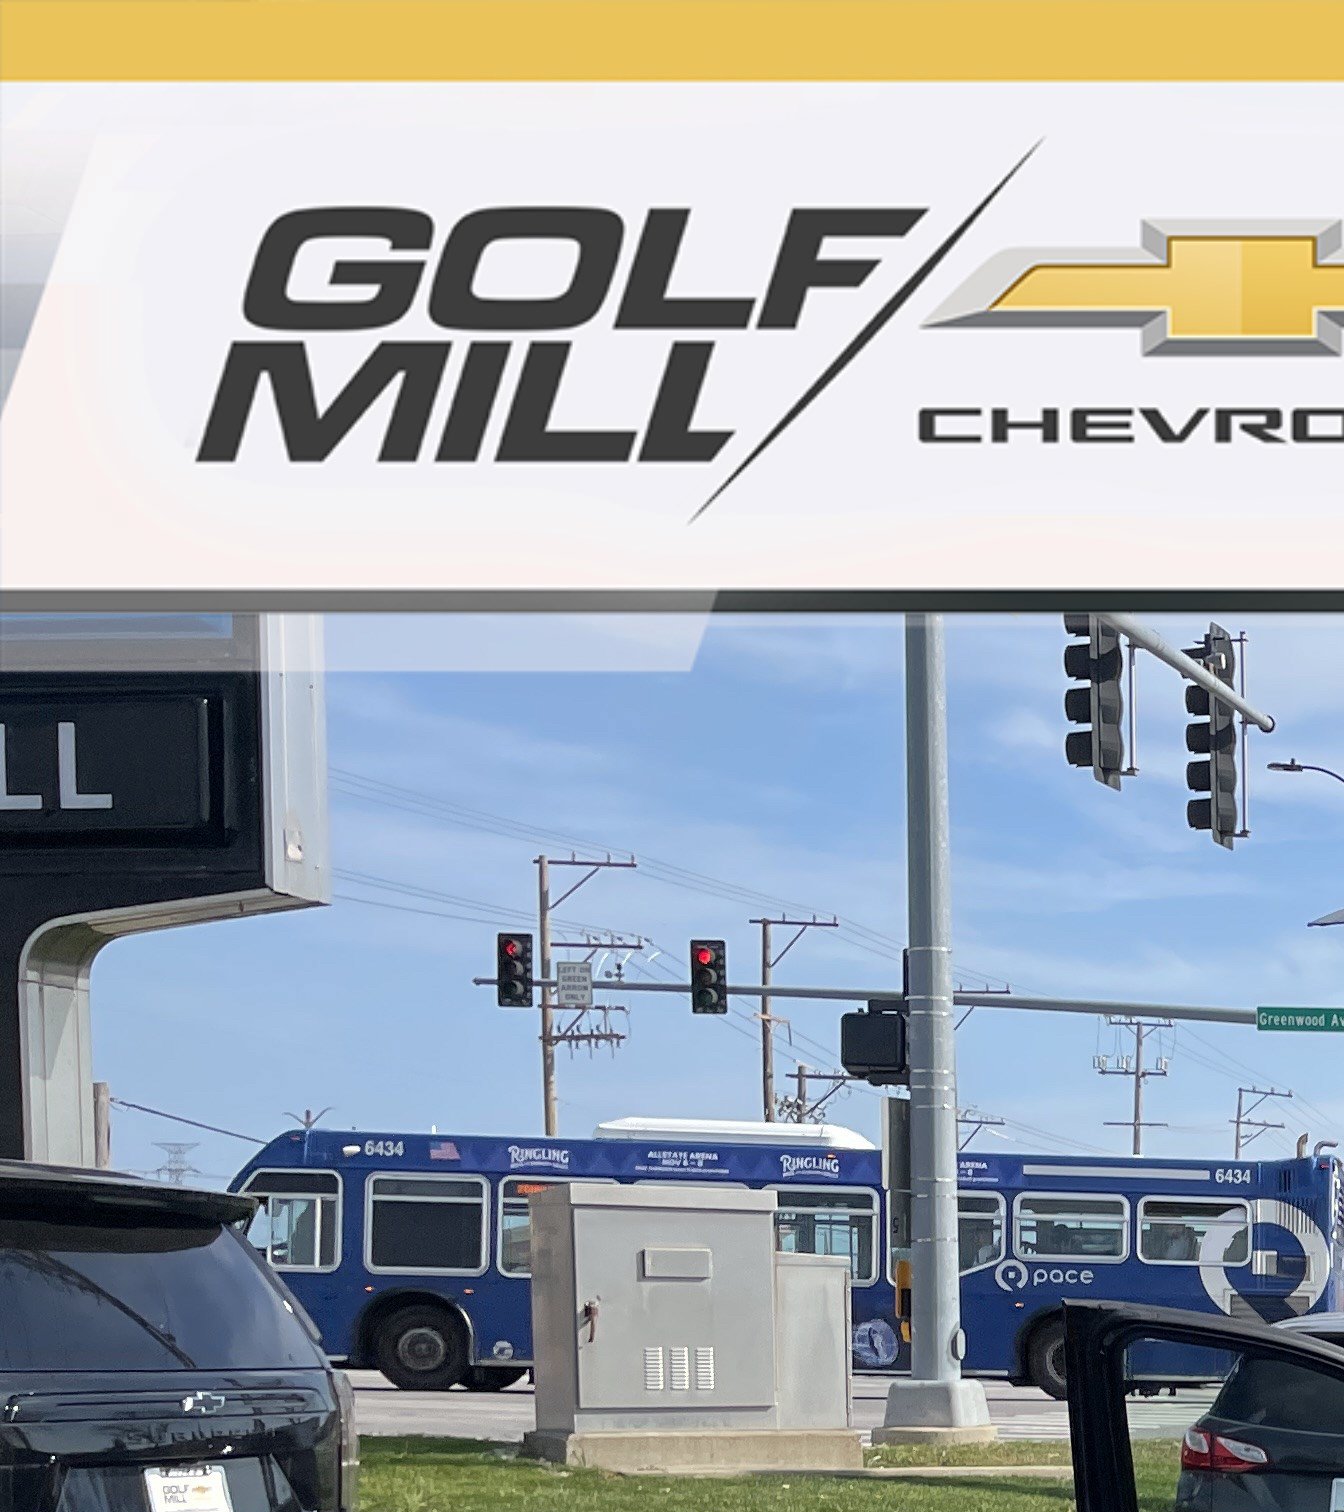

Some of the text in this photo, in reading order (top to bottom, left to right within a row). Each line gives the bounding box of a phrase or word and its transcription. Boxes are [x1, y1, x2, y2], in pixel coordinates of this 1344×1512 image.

[1259, 1012, 1325, 1027] Greenwood
[364, 1140, 404, 1157] 6434
[508, 1145, 569, 1164] RINGLING
[780, 1154, 839, 1173] RINGLING
[1215, 1168, 1250, 1185] 6434
[1033, 1268, 1094, 1287] pace
[163, 1484, 189, 1495] GOLF
